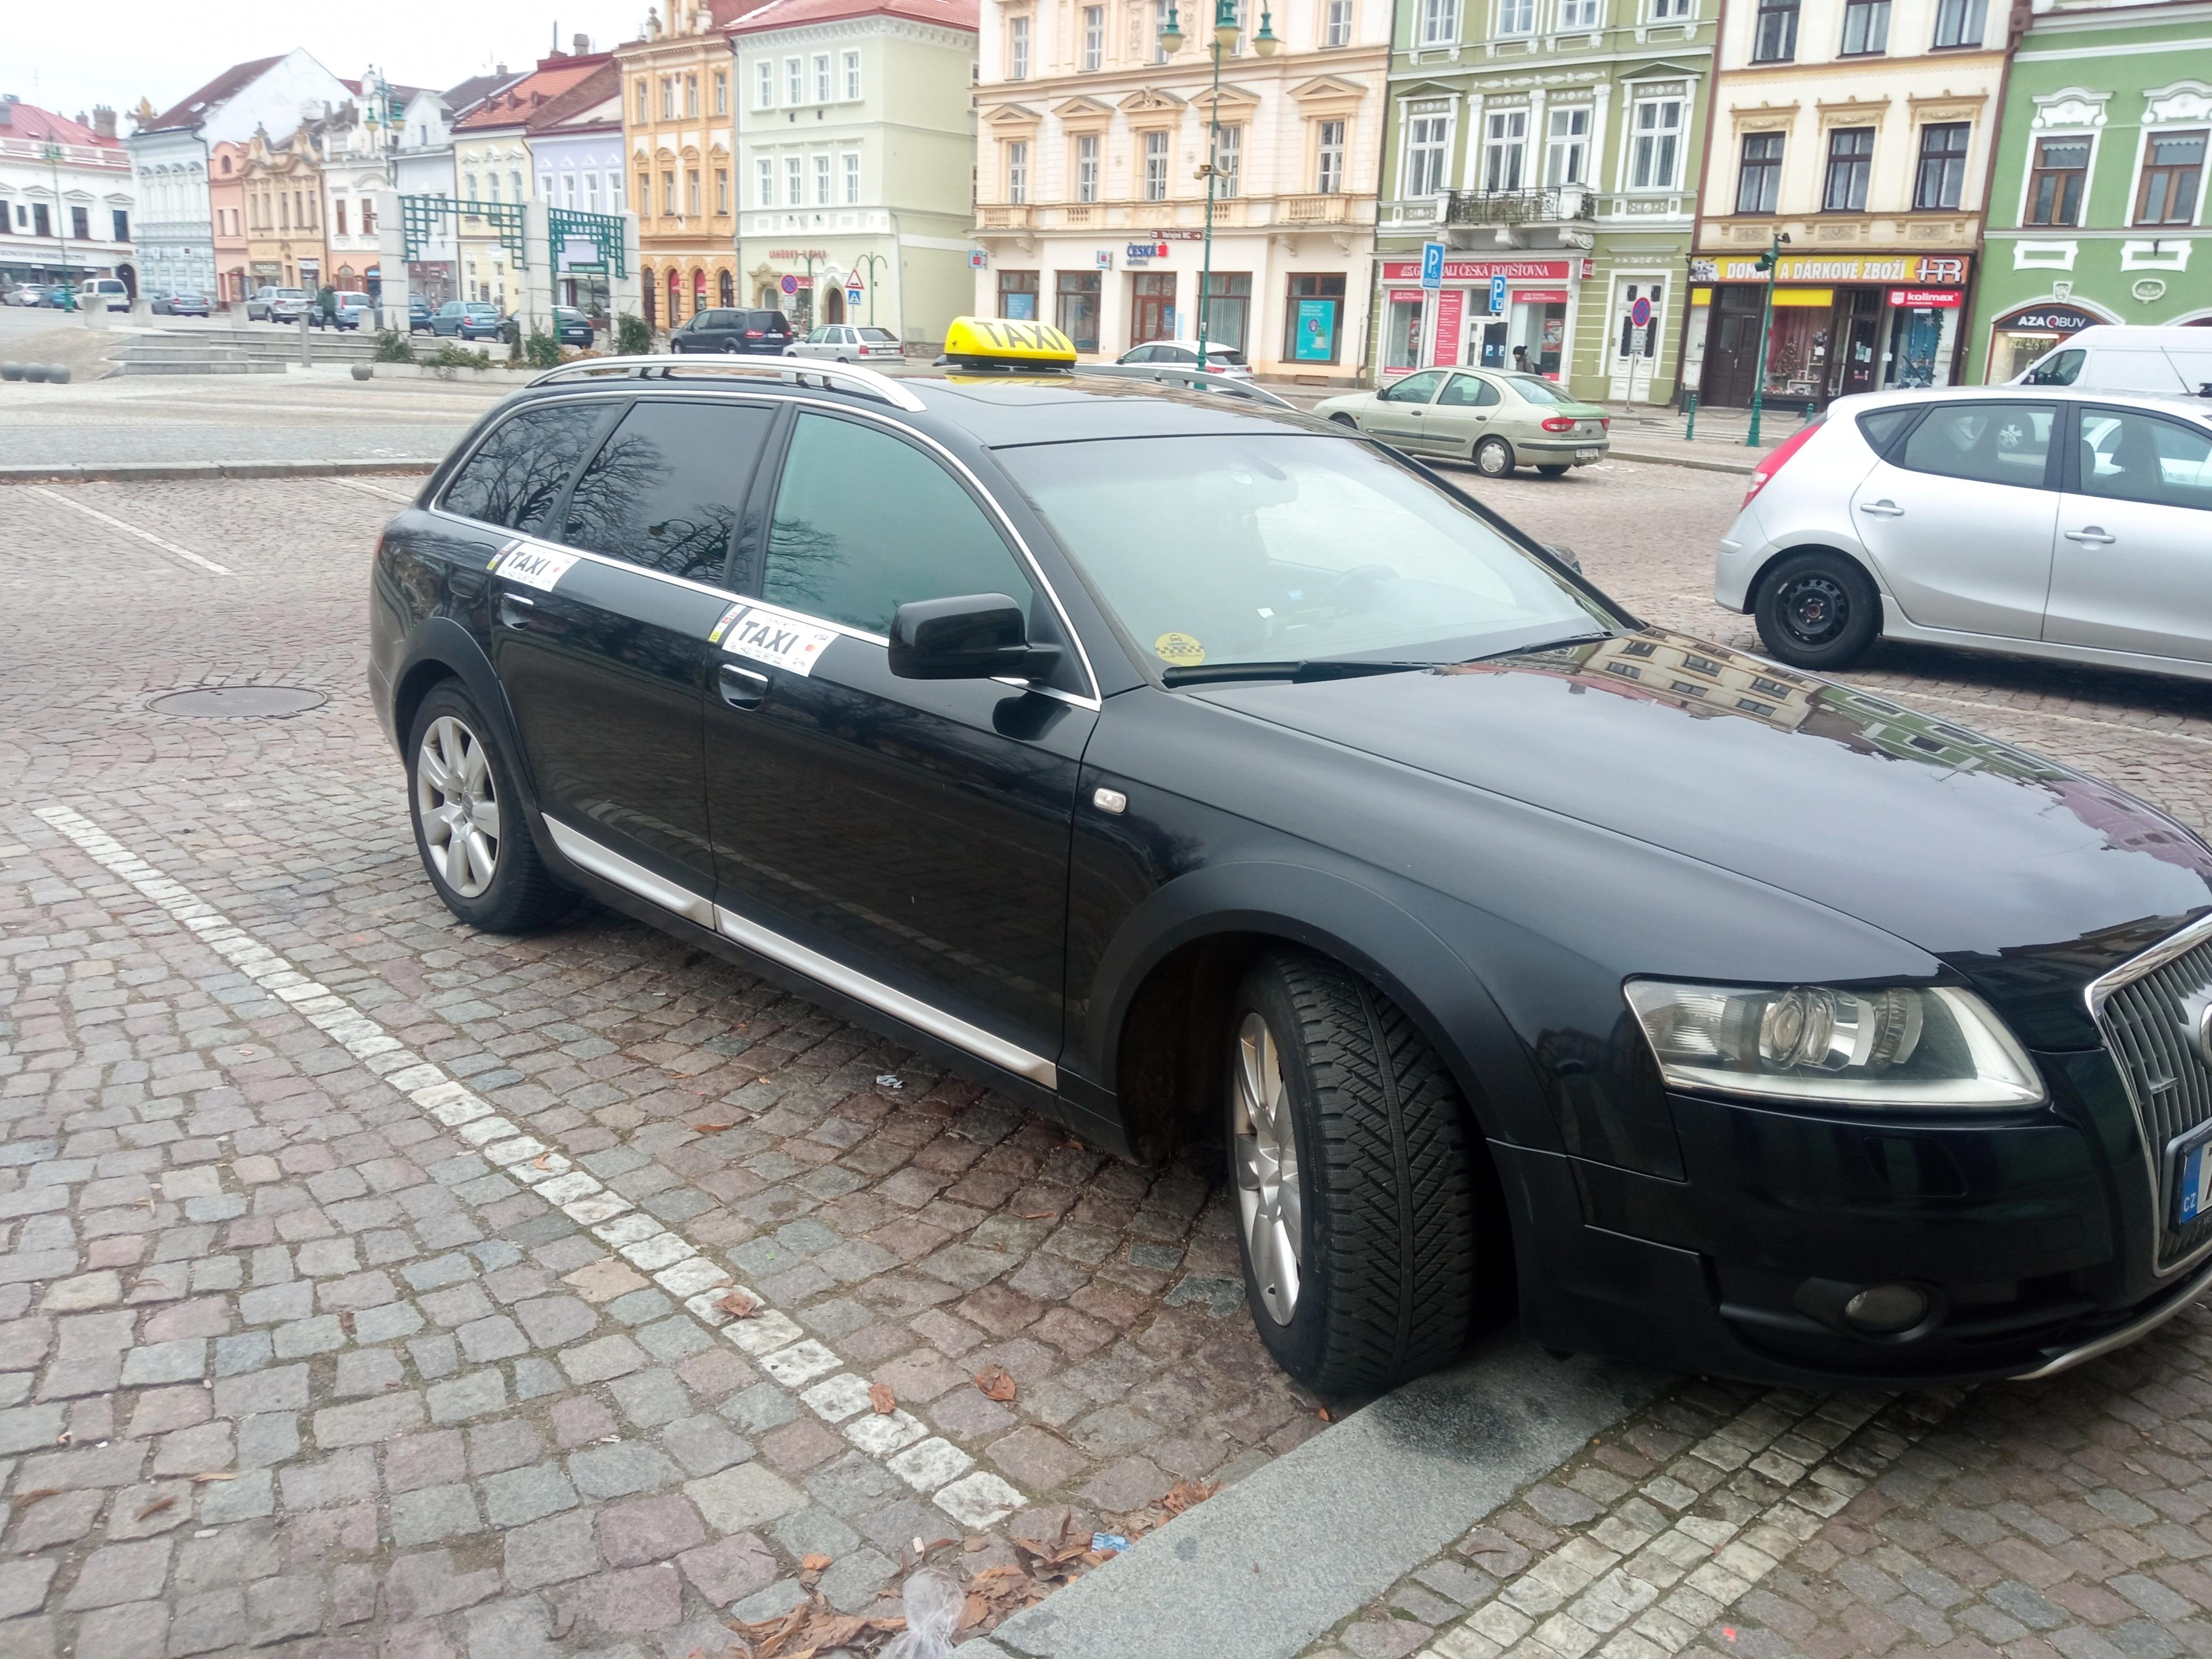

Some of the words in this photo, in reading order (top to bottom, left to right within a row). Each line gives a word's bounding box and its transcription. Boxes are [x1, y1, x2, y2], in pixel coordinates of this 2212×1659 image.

[1127, 242, 1156, 257] ČESKÁ
[1413, 265, 1457, 276] GALI
[1459, 263, 1489, 276] ČESKÁ
[1491, 263, 1550, 276] POJIŠŤOVNA
[1428, 249, 1439, 274] P
[1779, 263, 1789, 279] A
[1793, 259, 1859, 279] DÁRKOVÉ
[1862, 259, 1907, 280] ZBOŽÍ
[1916, 258, 1963, 283] HR
[1493, 279, 1504, 300] P
[1907, 292, 1954, 301] kolimax
[2017, 316, 2046, 327] AZA
[2046, 315, 2086, 328] OBUV
[973, 321, 1066, 351] TAXI
[508, 551, 551, 576] TAXI
[738, 620, 800, 655] TAXI
[2183, 1192, 2197, 1212] CZ
